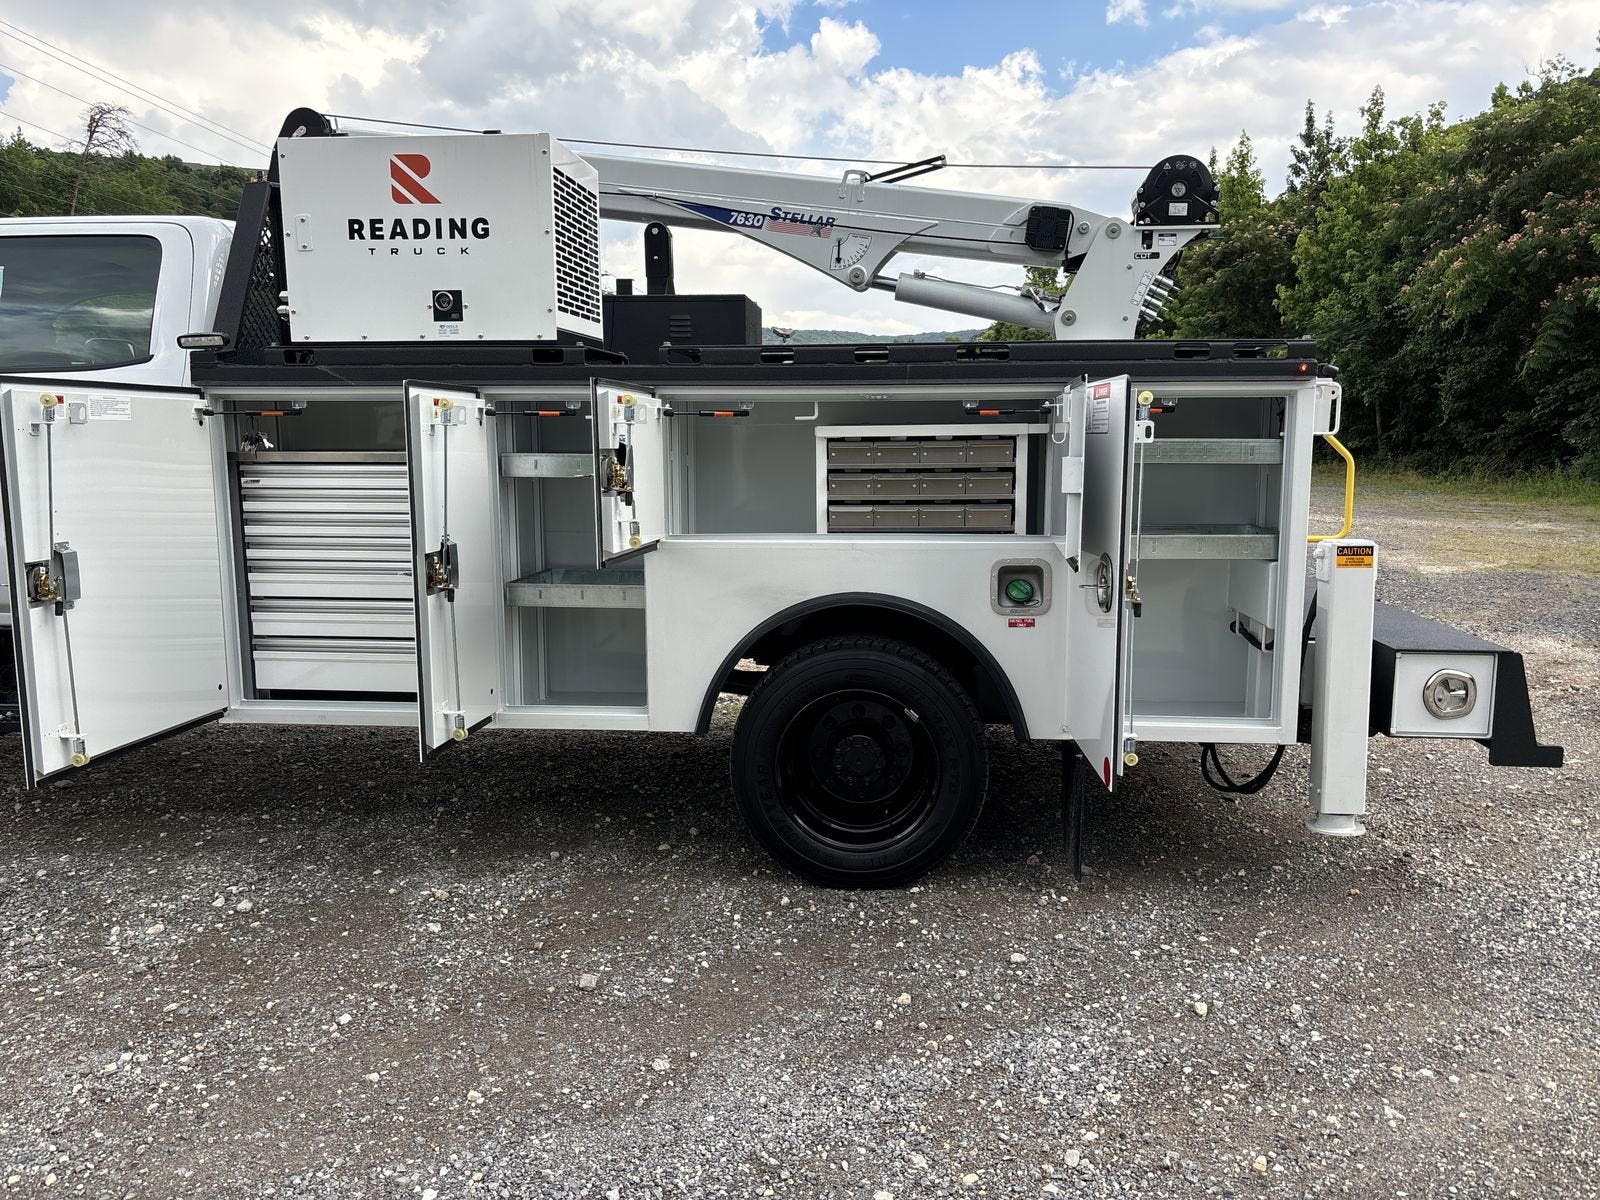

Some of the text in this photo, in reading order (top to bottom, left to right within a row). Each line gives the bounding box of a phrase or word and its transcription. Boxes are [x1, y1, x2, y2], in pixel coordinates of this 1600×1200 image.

[728, 211, 764, 227] 7630
[771, 206, 836, 227] STELLAR
[347, 217, 490, 240] READING
[368, 247, 470, 256] TRUCK
[1337, 547, 1372, 555] CAUTION
